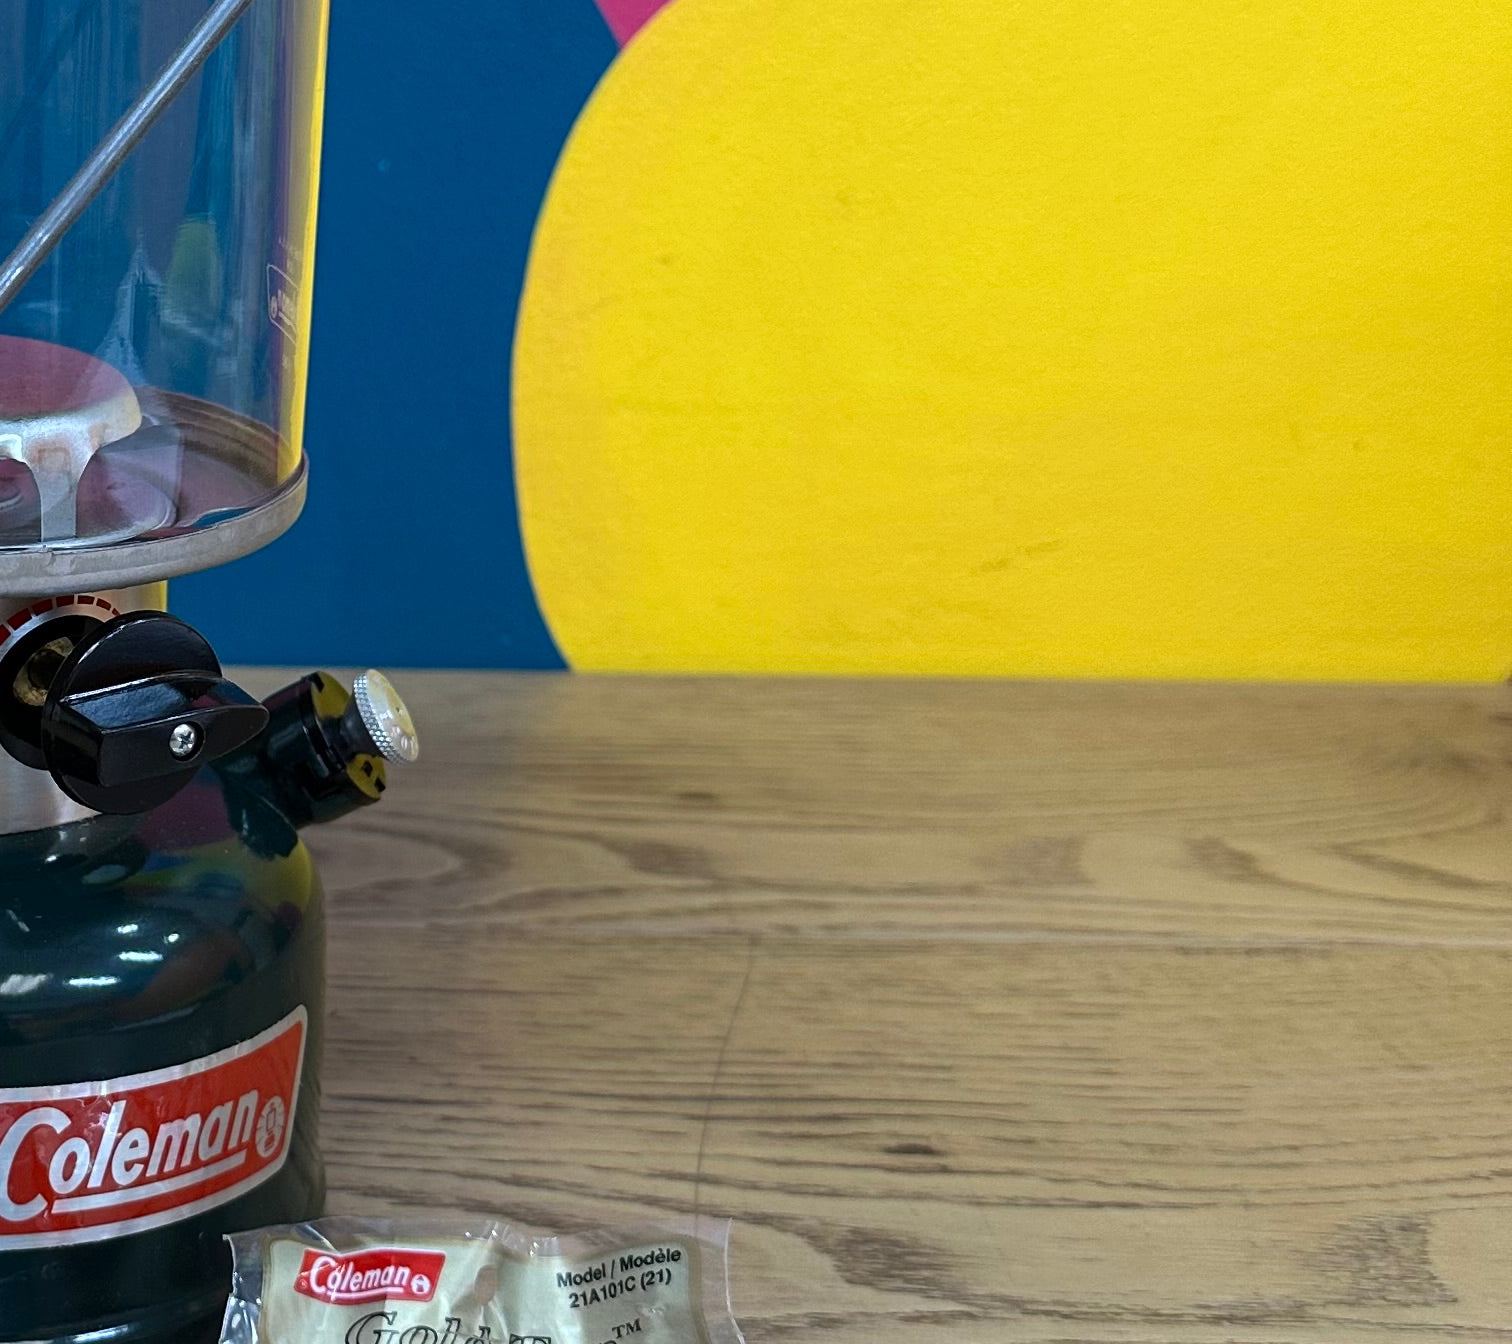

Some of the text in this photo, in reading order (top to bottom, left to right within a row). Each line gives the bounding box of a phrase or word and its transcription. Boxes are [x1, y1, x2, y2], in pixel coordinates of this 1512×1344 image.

[310, 1256, 409, 1295] Coleman
[556, 1264, 607, 1289] Model
[618, 1248, 682, 1274] Modèle
[568, 1267, 673, 1310] 21A101C (21)
